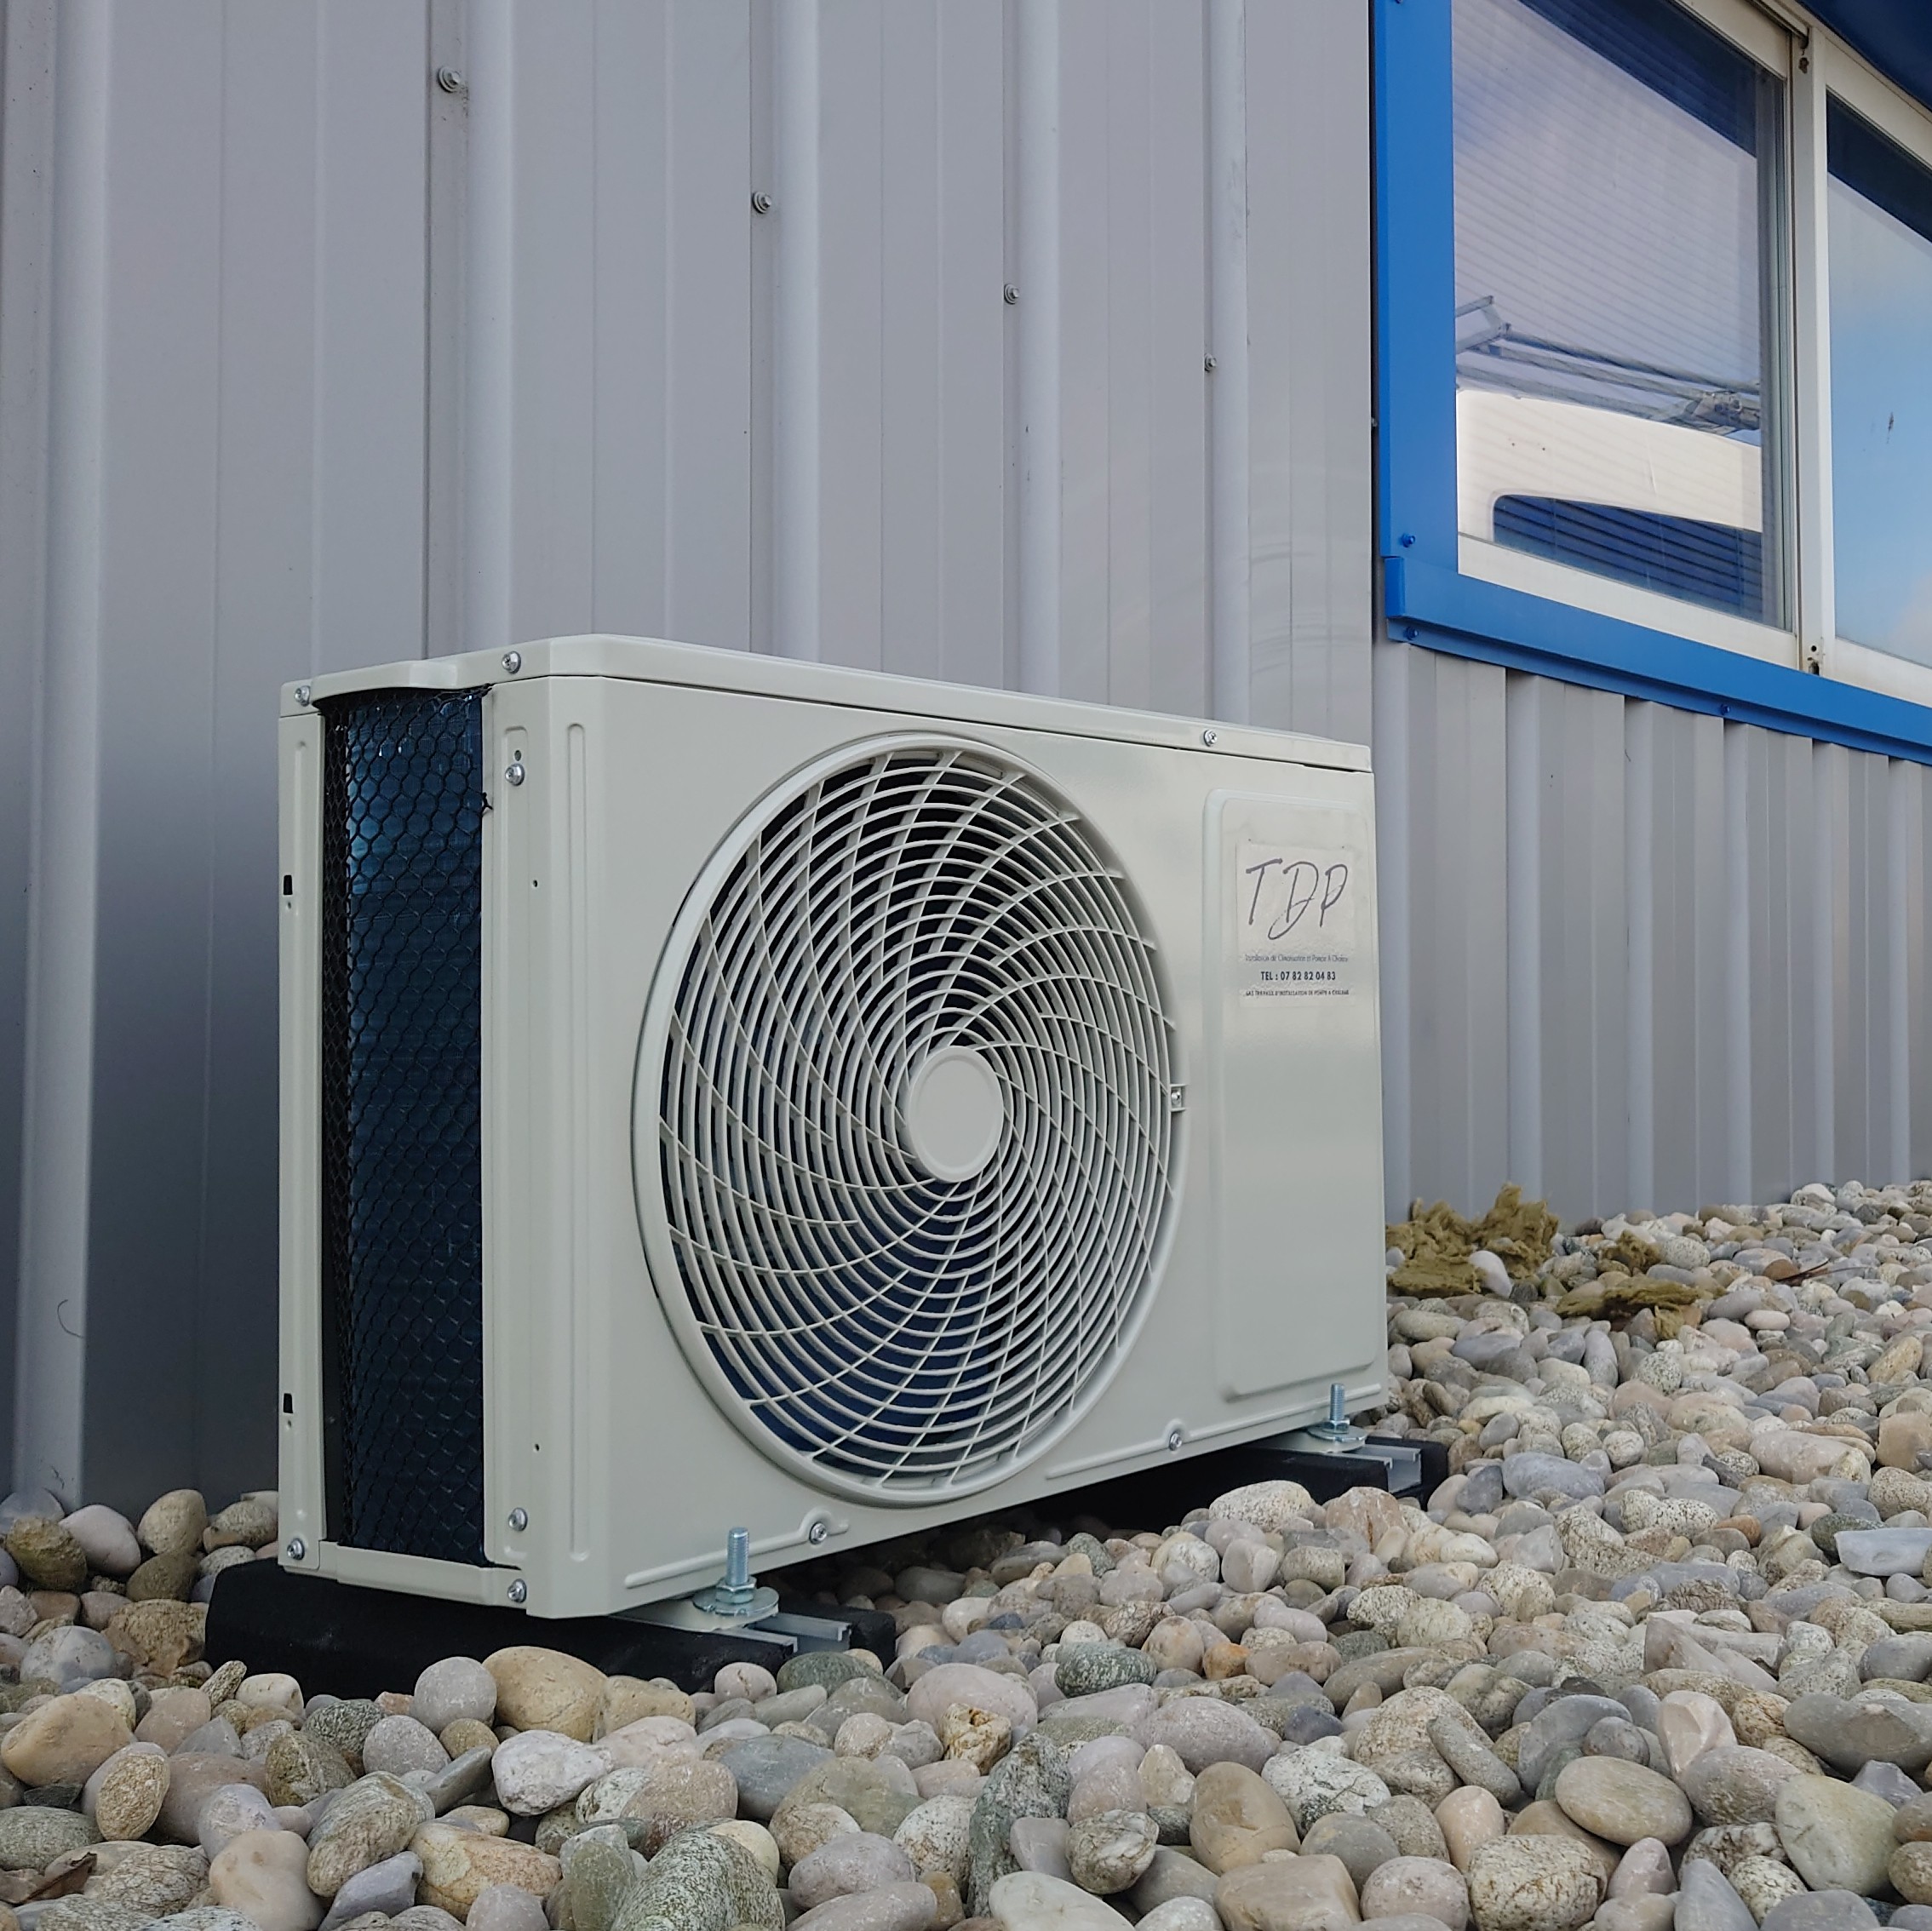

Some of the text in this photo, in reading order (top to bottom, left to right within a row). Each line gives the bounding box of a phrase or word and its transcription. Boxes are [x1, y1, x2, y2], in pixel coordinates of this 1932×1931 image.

[1246, 858, 1348, 940] TDP
[1261, 971, 1273, 980] TEL
[1280, 971, 1290, 980] 07
[1292, 971, 1302, 980] 82
[1304, 971, 1314, 980] 82
[1316, 971, 1325, 980] 04
[1327, 971, 1336, 980] 83
